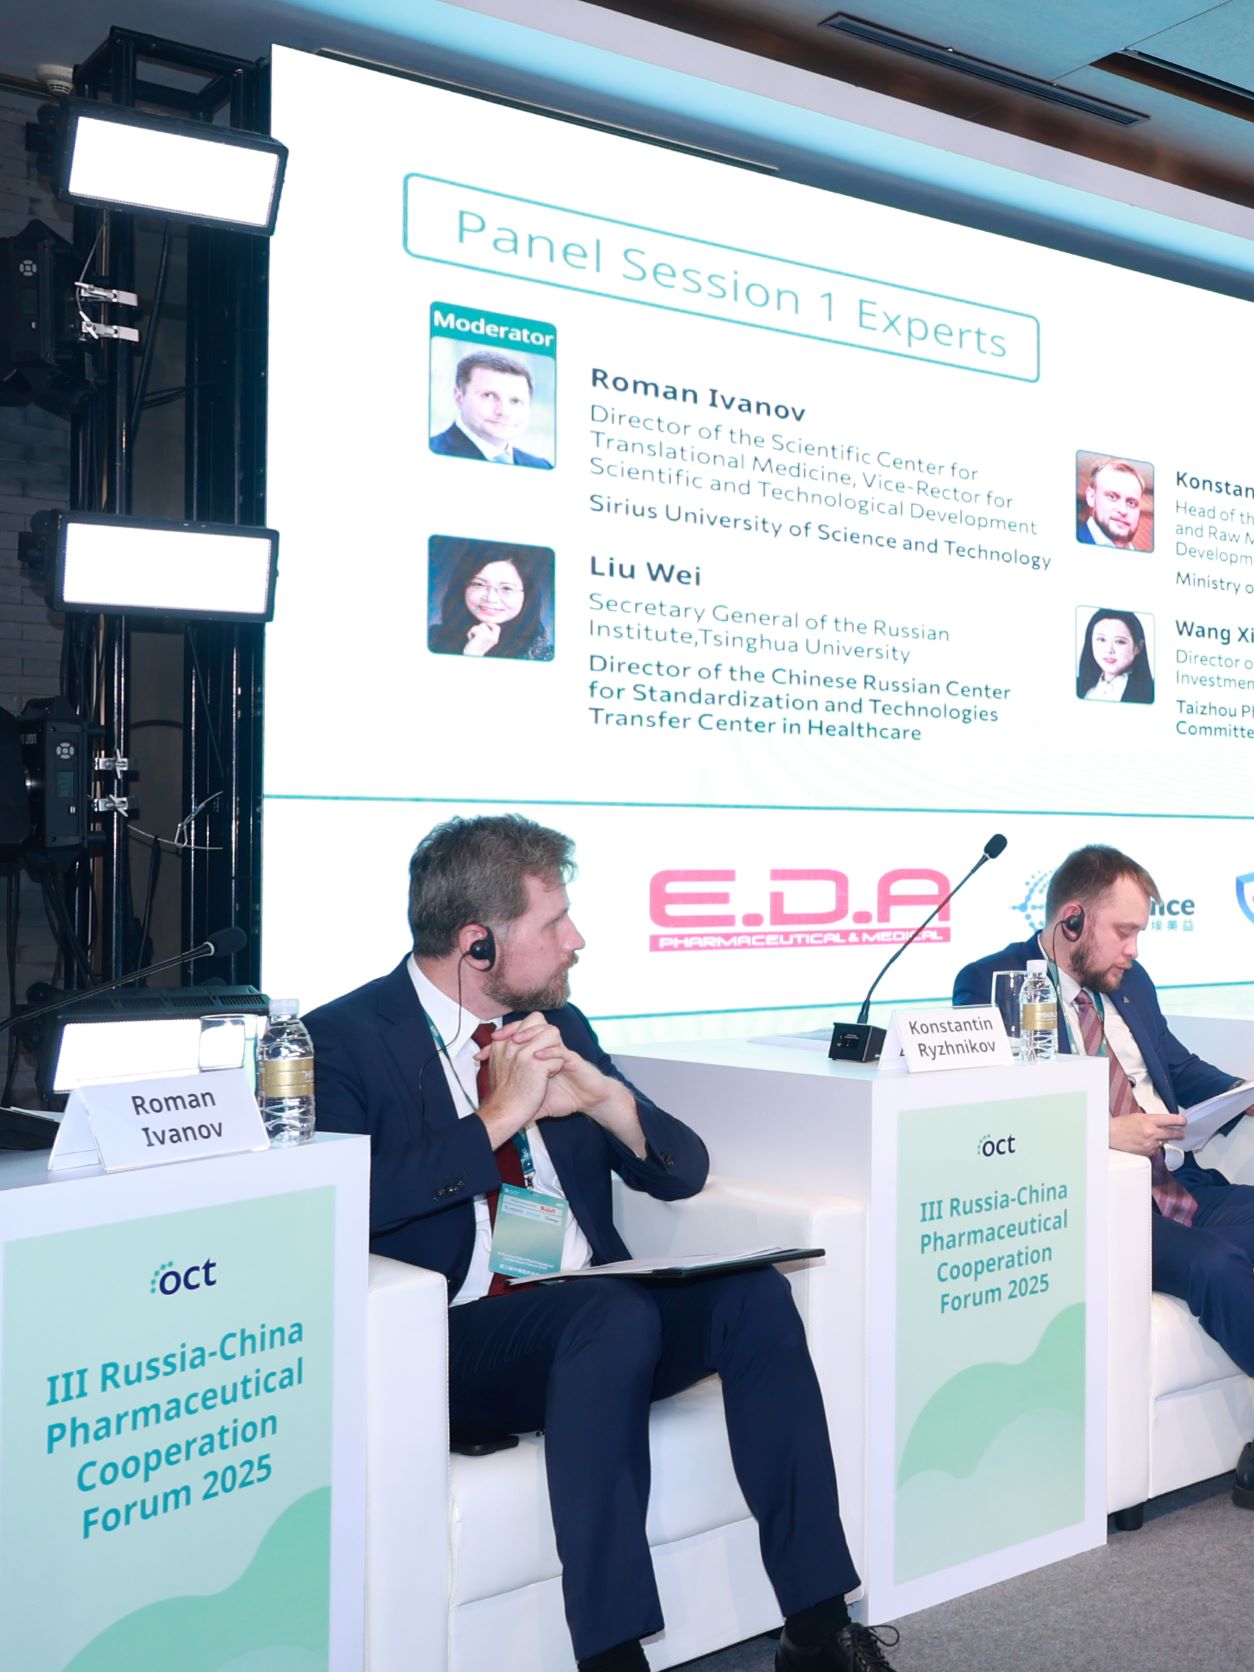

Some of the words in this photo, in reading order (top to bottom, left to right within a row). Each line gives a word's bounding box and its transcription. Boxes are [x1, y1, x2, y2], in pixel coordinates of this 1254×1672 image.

[457, 208, 601, 273] Panel
[621, 246, 800, 315] Session
[819, 290, 833, 322] 1
[857, 297, 1007, 358] Experts
[433, 309, 555, 347] Moderator
[591, 367, 698, 405] Roman
[708, 387, 806, 422] Ivanov
[590, 403, 692, 436] Director
[697, 423, 723, 441] of
[728, 427, 765, 449] the
[771, 432, 871, 465] Scientific
[876, 450, 945, 475] Center
[949, 461, 978, 481] for
[589, 429, 745, 469] Translational
[752, 455, 856, 489] Medicine,
[861, 471, 981, 504] Vice-Rector
[985, 489, 1014, 509] for
[589, 455, 703, 490] Scientific
[709, 478, 751, 496] and
[756, 479, 904, 517] Technological
[909, 501, 1037, 536] Development
[1175, 498, 1216, 520] Head
[1218, 507, 1236, 522] of
[588, 493, 658, 520] Sirius
[664, 503, 783, 539] University
[788, 520, 812, 538] of
[816, 523, 897, 550] Science
[901, 537, 939, 554] and
[943, 539, 1052, 571] Technology
[1175, 523, 1204, 538] and
[1207, 524, 1241, 544] Raw
[590, 554, 635, 580] Liu
[645, 560, 701, 587] Wei
[1175, 570, 1241, 595] Ministry
[588, 591, 706, 624] Secretary
[711, 603, 799, 628] General
[804, 613, 828, 631] of
[832, 615, 868, 635] the
[873, 618, 950, 642] Russian
[1174, 619, 1231, 646] Wang
[589, 653, 692, 678] Director
[697, 662, 723, 680] of
[727, 664, 765, 684] the
[770, 666, 857, 690] Chinese
[862, 673, 941, 695] Russian
[945, 679, 1011, 700] Center
[1175, 647, 1241, 669] Director
[587, 679, 626, 700] for
[632, 683, 819, 712] Standardization
[823, 696, 864, 715] and
[867, 697, 999, 725] Technologies
[1175, 698, 1237, 718] Taizhou
[587, 706, 692, 730] Transfer
[697, 712, 777, 734] Center
[781, 716, 801, 735] in
[807, 718, 922, 741] Healthcare
[650, 868, 951, 928] E.D.A
[659, 932, 846, 949] PHARMACEUTICAL
[848, 931, 860, 943] &
[908, 1016, 994, 1036] Konstantin
[917, 1038, 997, 1060] Ryzhnikov
[131, 1086, 217, 1117] Roman
[144, 1118, 224, 1148] Ivanov
[982, 1133, 1016, 1158] oct
[919, 1199, 944, 1223] III
[949, 1183, 1069, 1218] Russia-China
[919, 1208, 1069, 1255] Pharmaceutical
[159, 1258, 218, 1296] oct
[936, 1244, 1053, 1284] Cooperation
[940, 1285, 1002, 1315] Forum
[1007, 1273, 1050, 1301] 2025
[46, 1368, 89, 1407] III
[100, 1321, 305, 1394] Russia-China
[46, 1356, 305, 1455] Pharmaceutical
[76, 1413, 279, 1494] Cooperation
[82, 1485, 193, 1540] Forum
[202, 1453, 273, 1501] 2025
